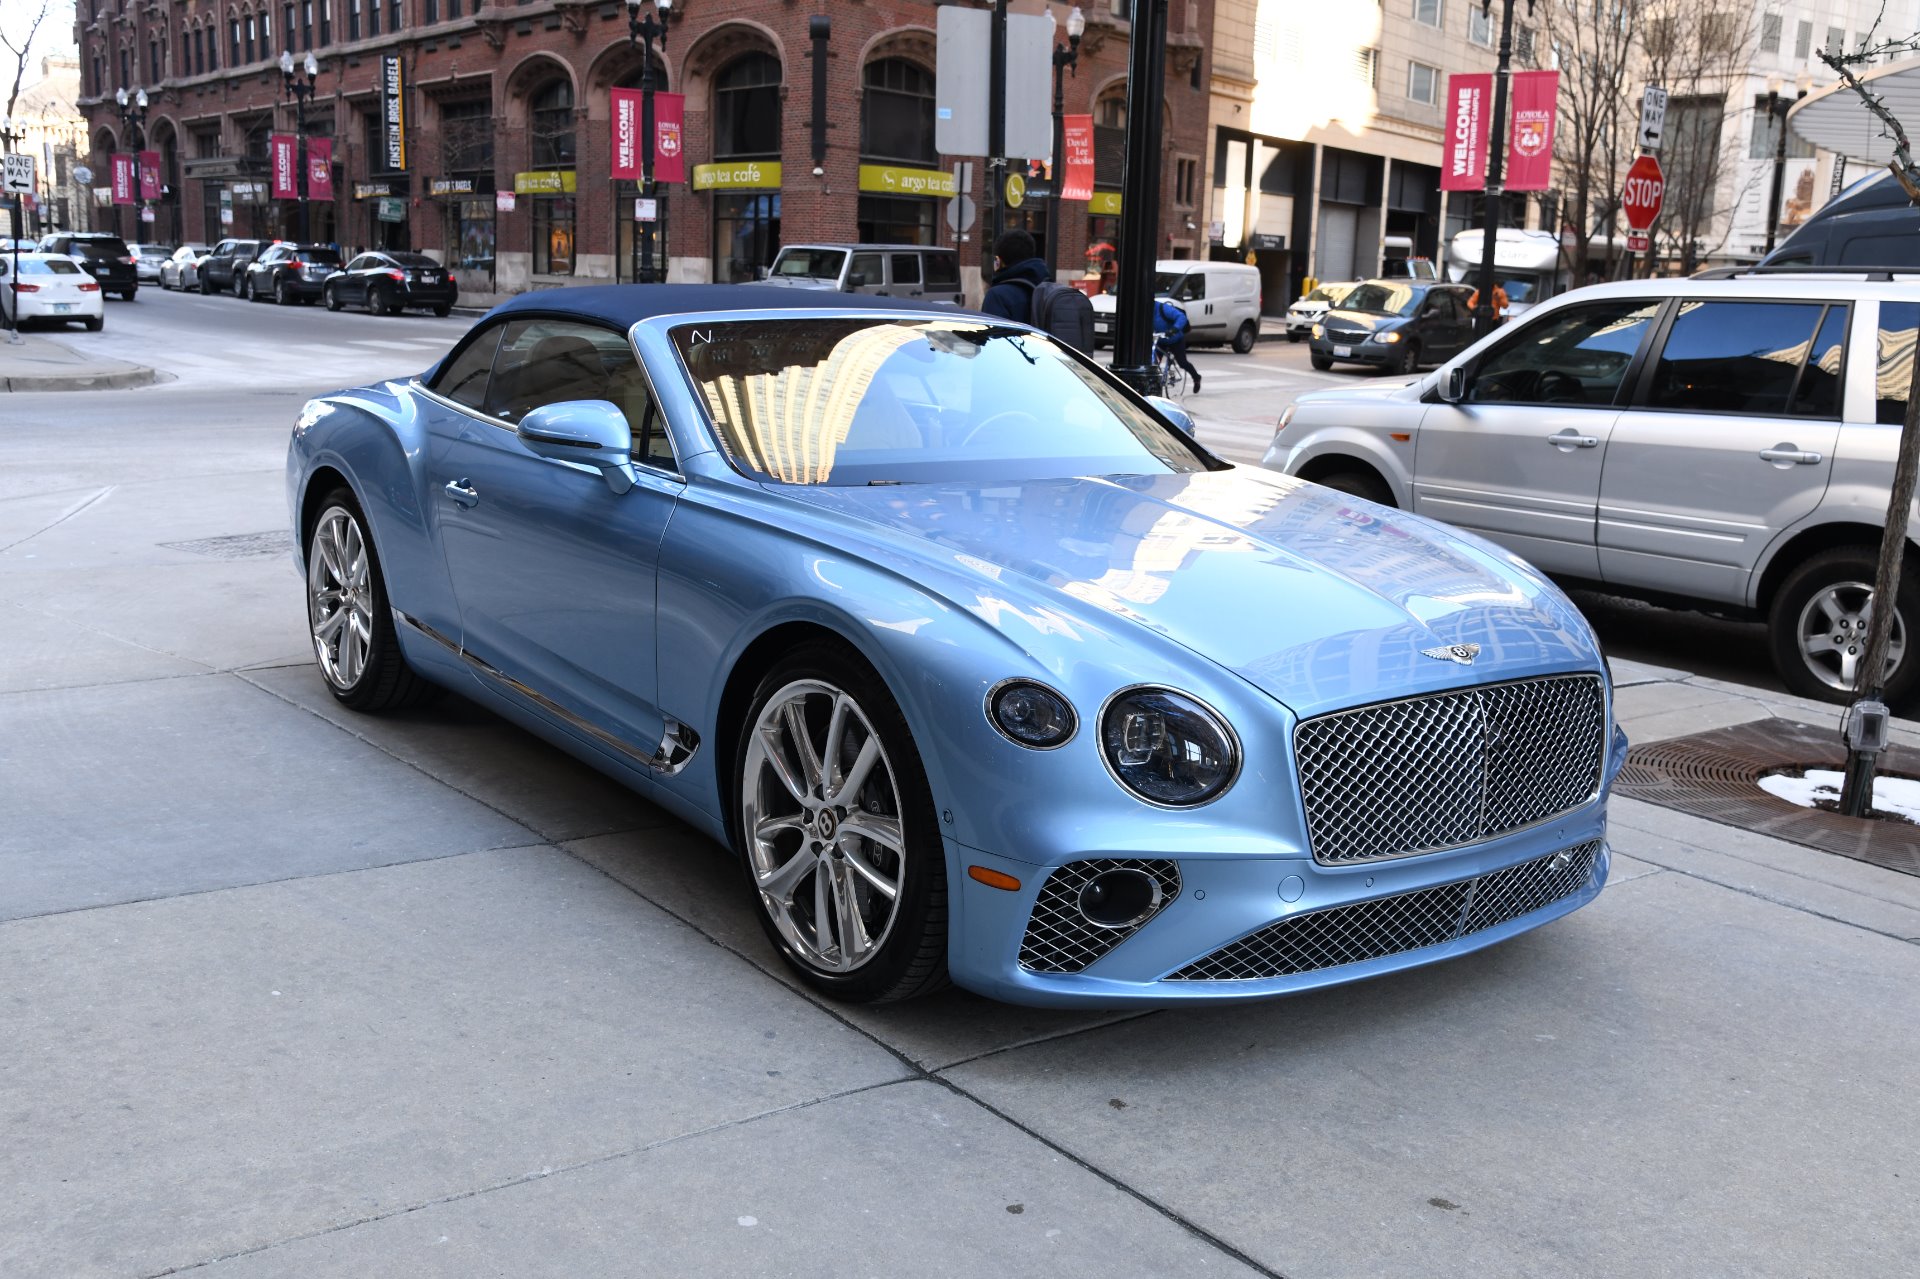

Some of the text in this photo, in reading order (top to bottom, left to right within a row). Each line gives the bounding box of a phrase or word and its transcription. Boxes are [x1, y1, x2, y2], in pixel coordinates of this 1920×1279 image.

[387, 57, 399, 95] BAGELS
[1646, 92, 1665, 109] ONE
[1516, 110, 1550, 120] LOYOLA
[1644, 109, 1662, 125] WAY
[619, 99, 629, 168] WELCOME
[1452, 87, 1473, 177] WELCOME
[1466, 88, 1481, 177] WATER TOWER CAMPUS
[388, 125, 401, 168] EINSTEIN
[7, 156, 31, 168] ONE
[7, 167, 31, 178] WAY
[277, 142, 287, 191] WELCOME
[717, 169, 730, 183] tea
[733, 163, 761, 182] café
[116, 159, 125, 199] WELCOME
[540, 171, 561, 188] café
[901, 175, 926, 193] argo
[927, 176, 940, 191] tea
[1625, 177, 1662, 209] STOP
